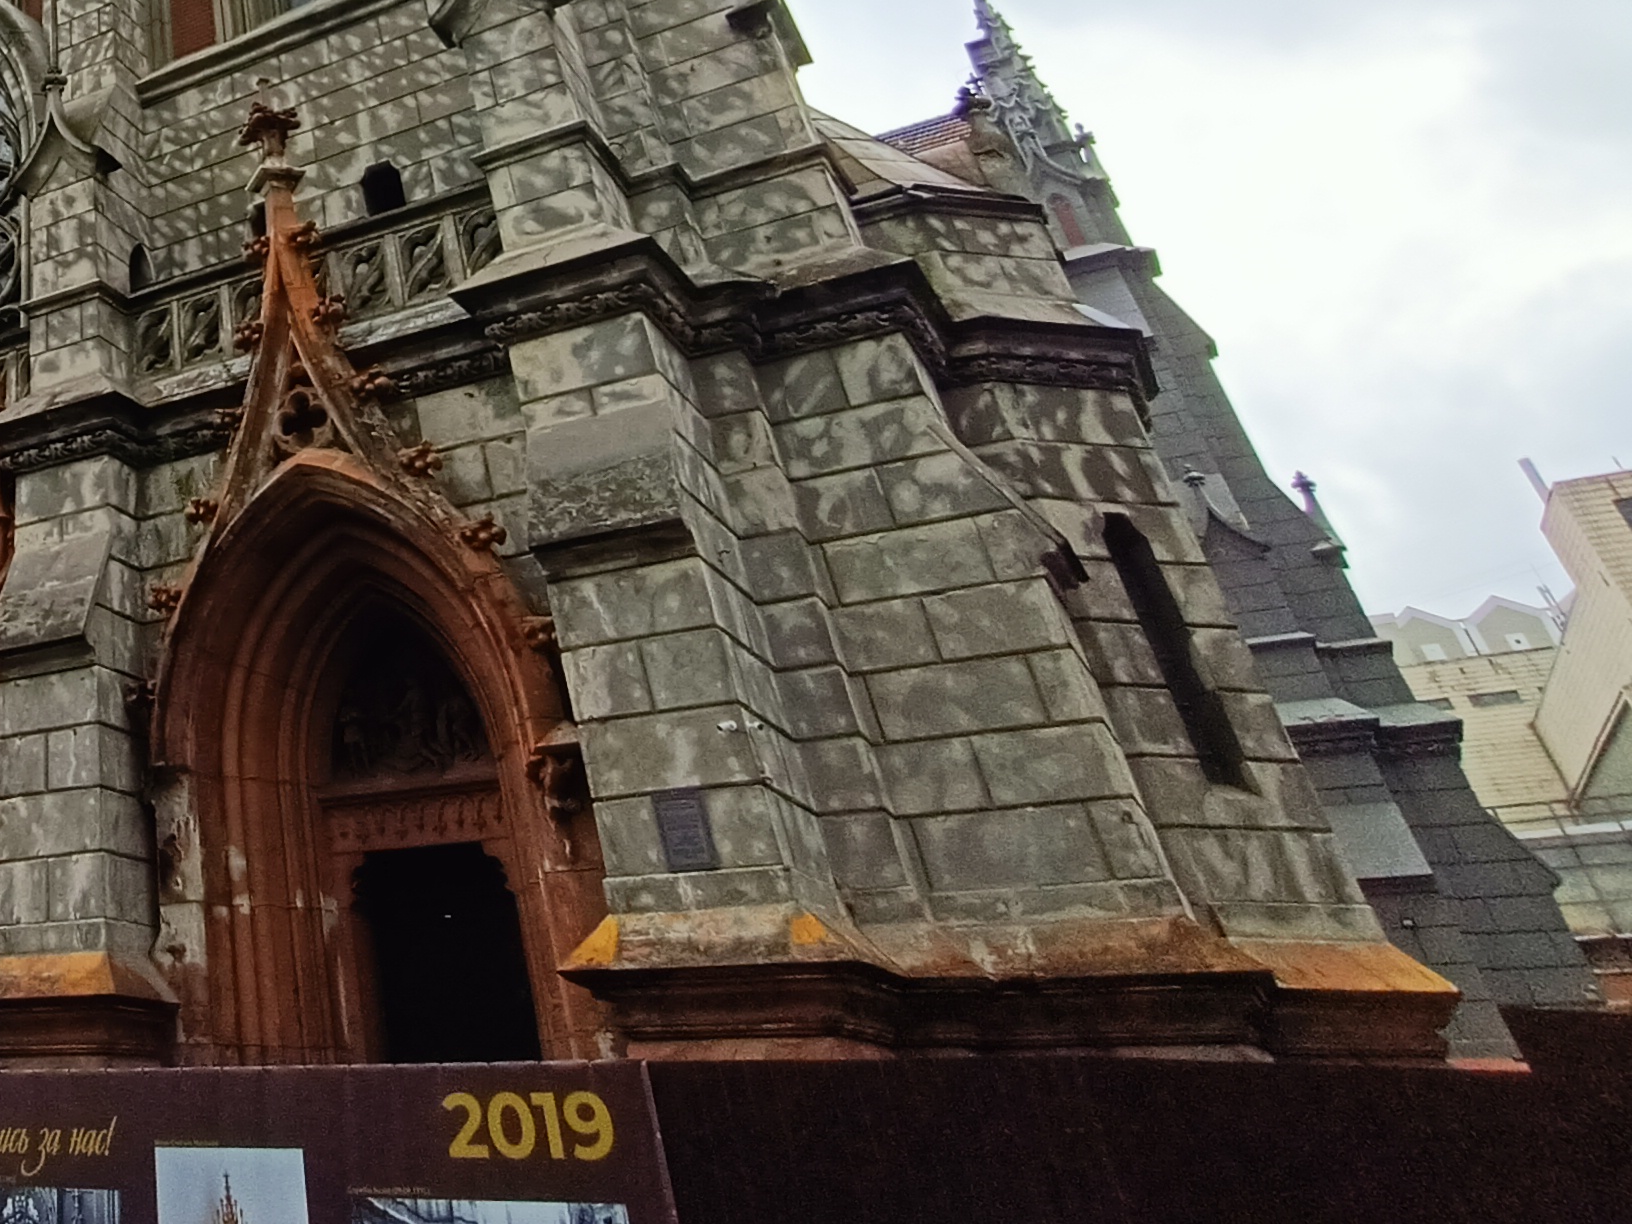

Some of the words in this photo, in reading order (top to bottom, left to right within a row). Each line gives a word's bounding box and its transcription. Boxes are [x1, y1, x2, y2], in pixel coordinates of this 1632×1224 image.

[20, 1127, 62, 1176] за
[68, 1115, 117, 1156] нас!
[442, 1092, 614, 1161] 2019
